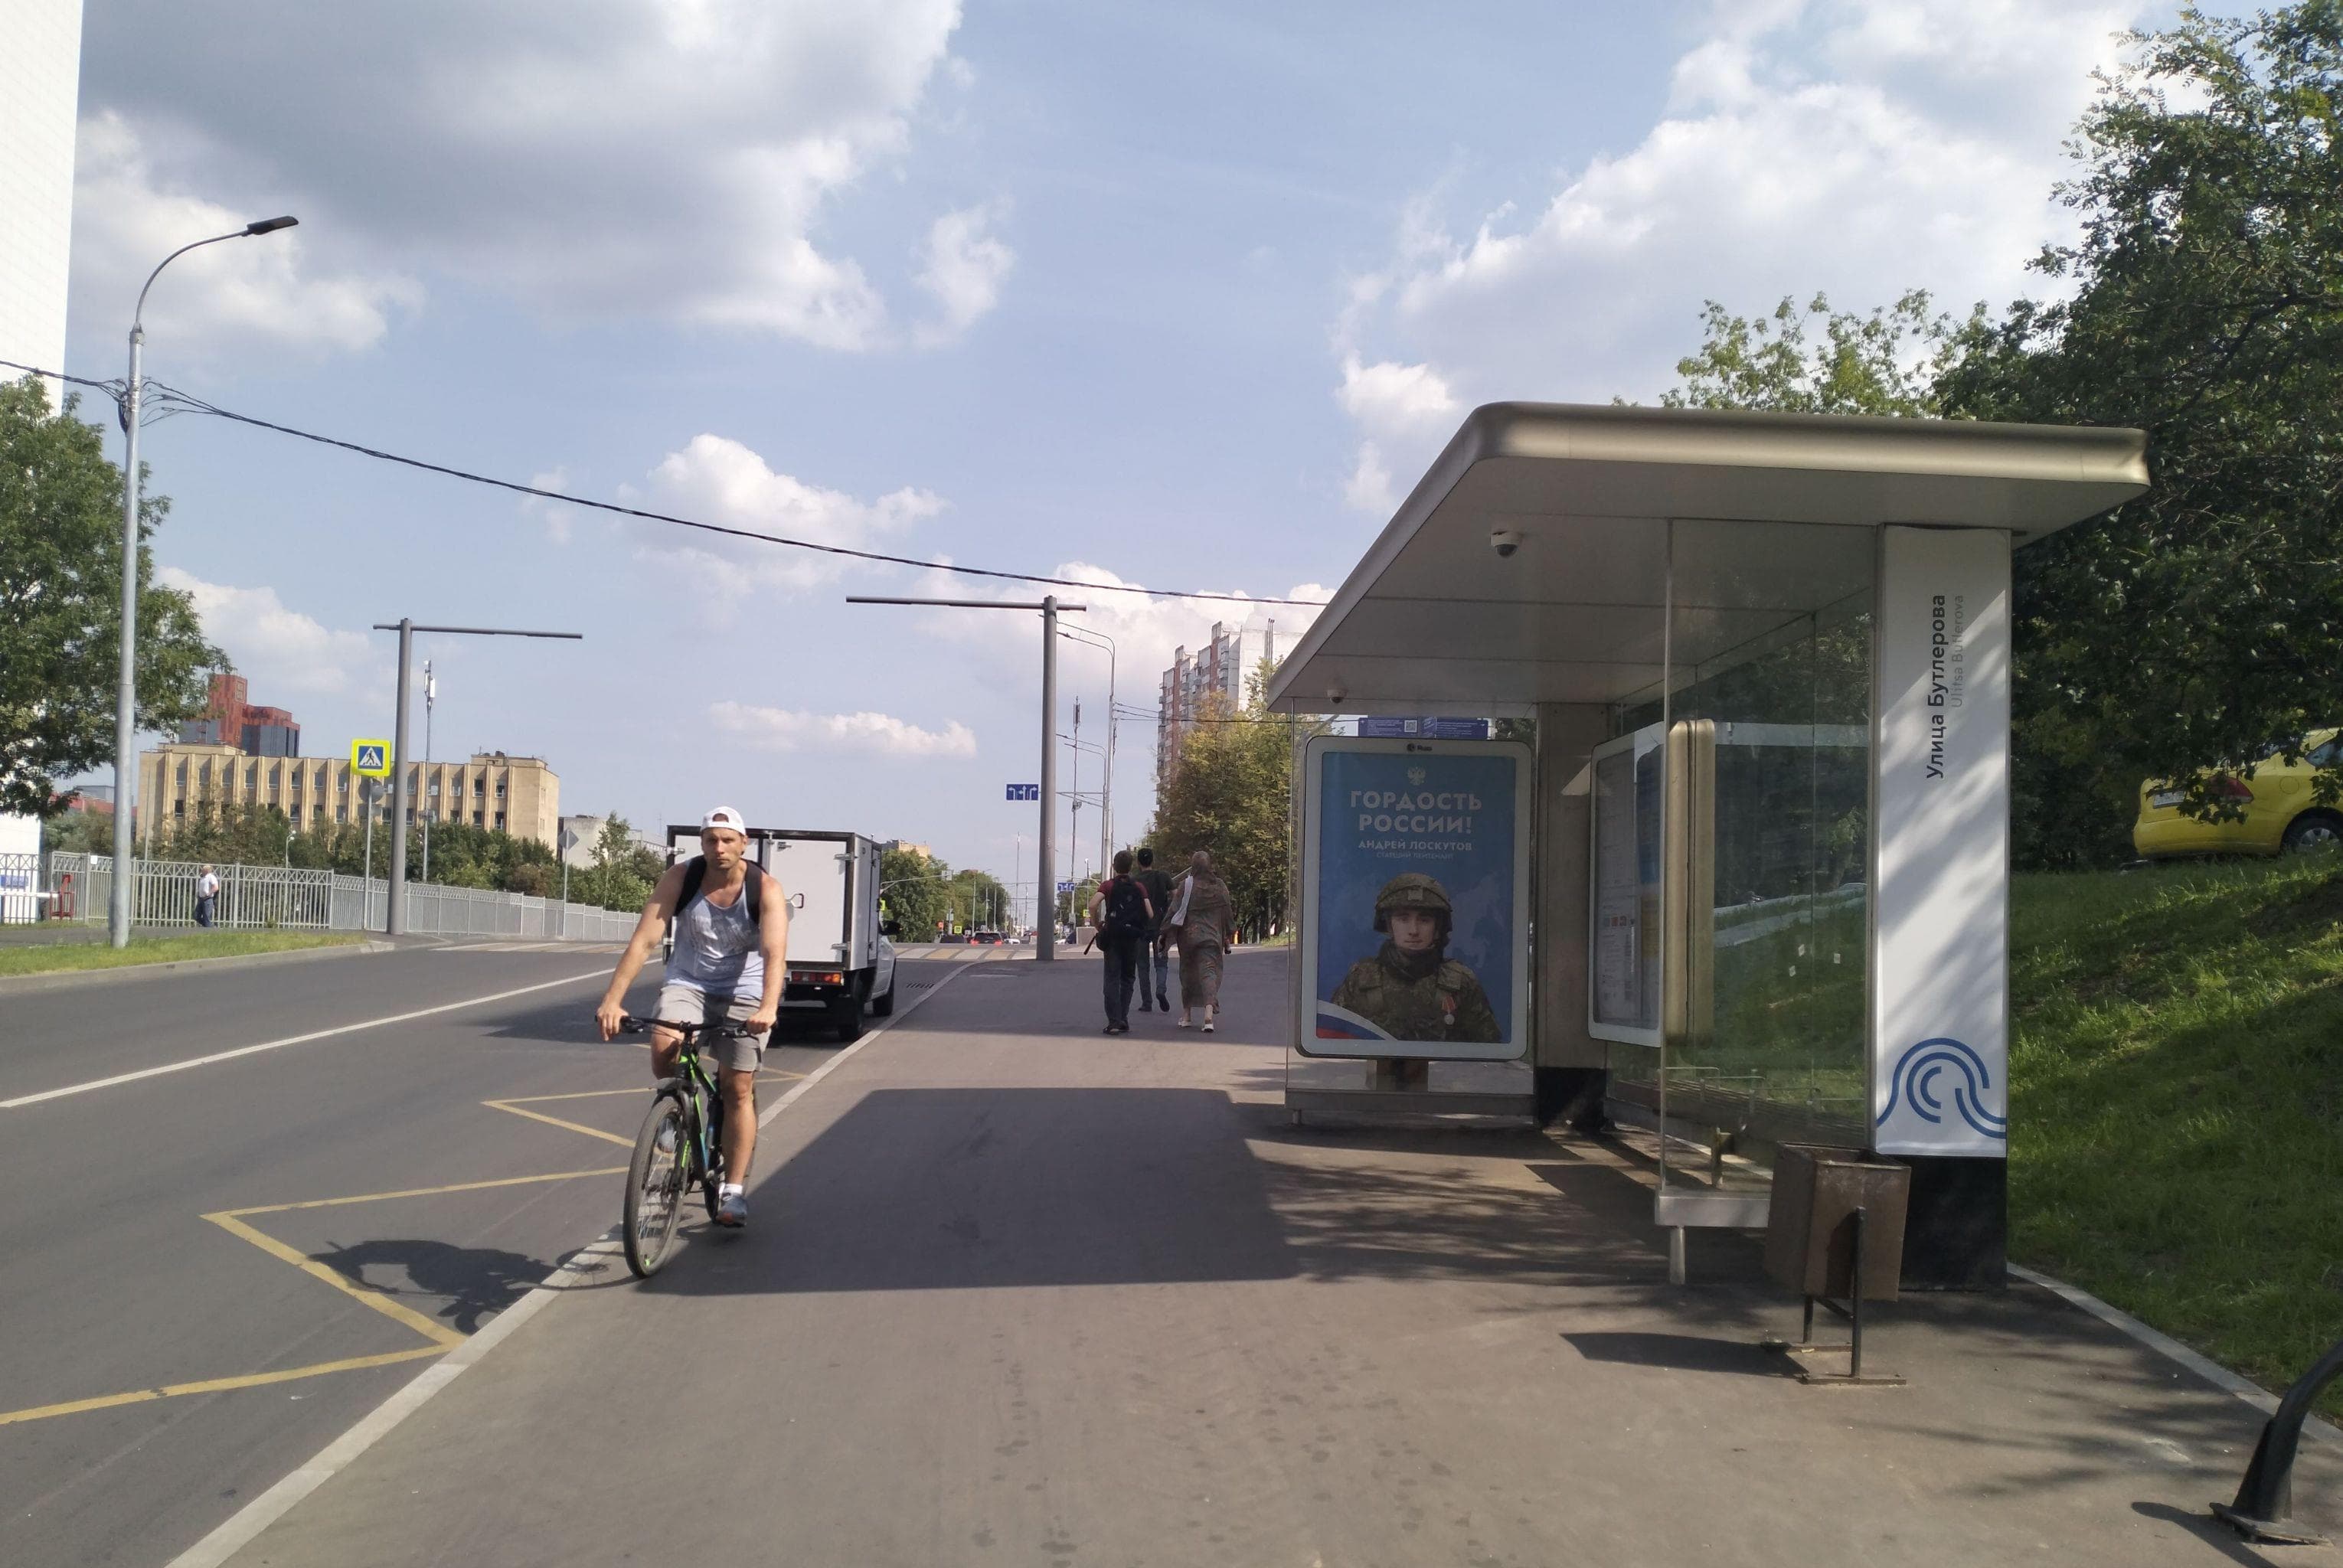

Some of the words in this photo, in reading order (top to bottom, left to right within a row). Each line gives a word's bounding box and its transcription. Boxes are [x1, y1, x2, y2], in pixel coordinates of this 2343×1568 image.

[1952, 595, 1963, 662] Butlerova
[1927, 595, 1949, 707] Бутлерова
[1951, 668, 1963, 707] Ulitsa
[1926, 714, 1946, 779] Улица
[1351, 791, 1482, 811] ГОРДОСТЬ
[1359, 814, 1472, 834] РОССИИ!
[1358, 839, 1406, 850] АНДРЕЙ
[1410, 841, 1472, 851] ЛОСКУТОВ
